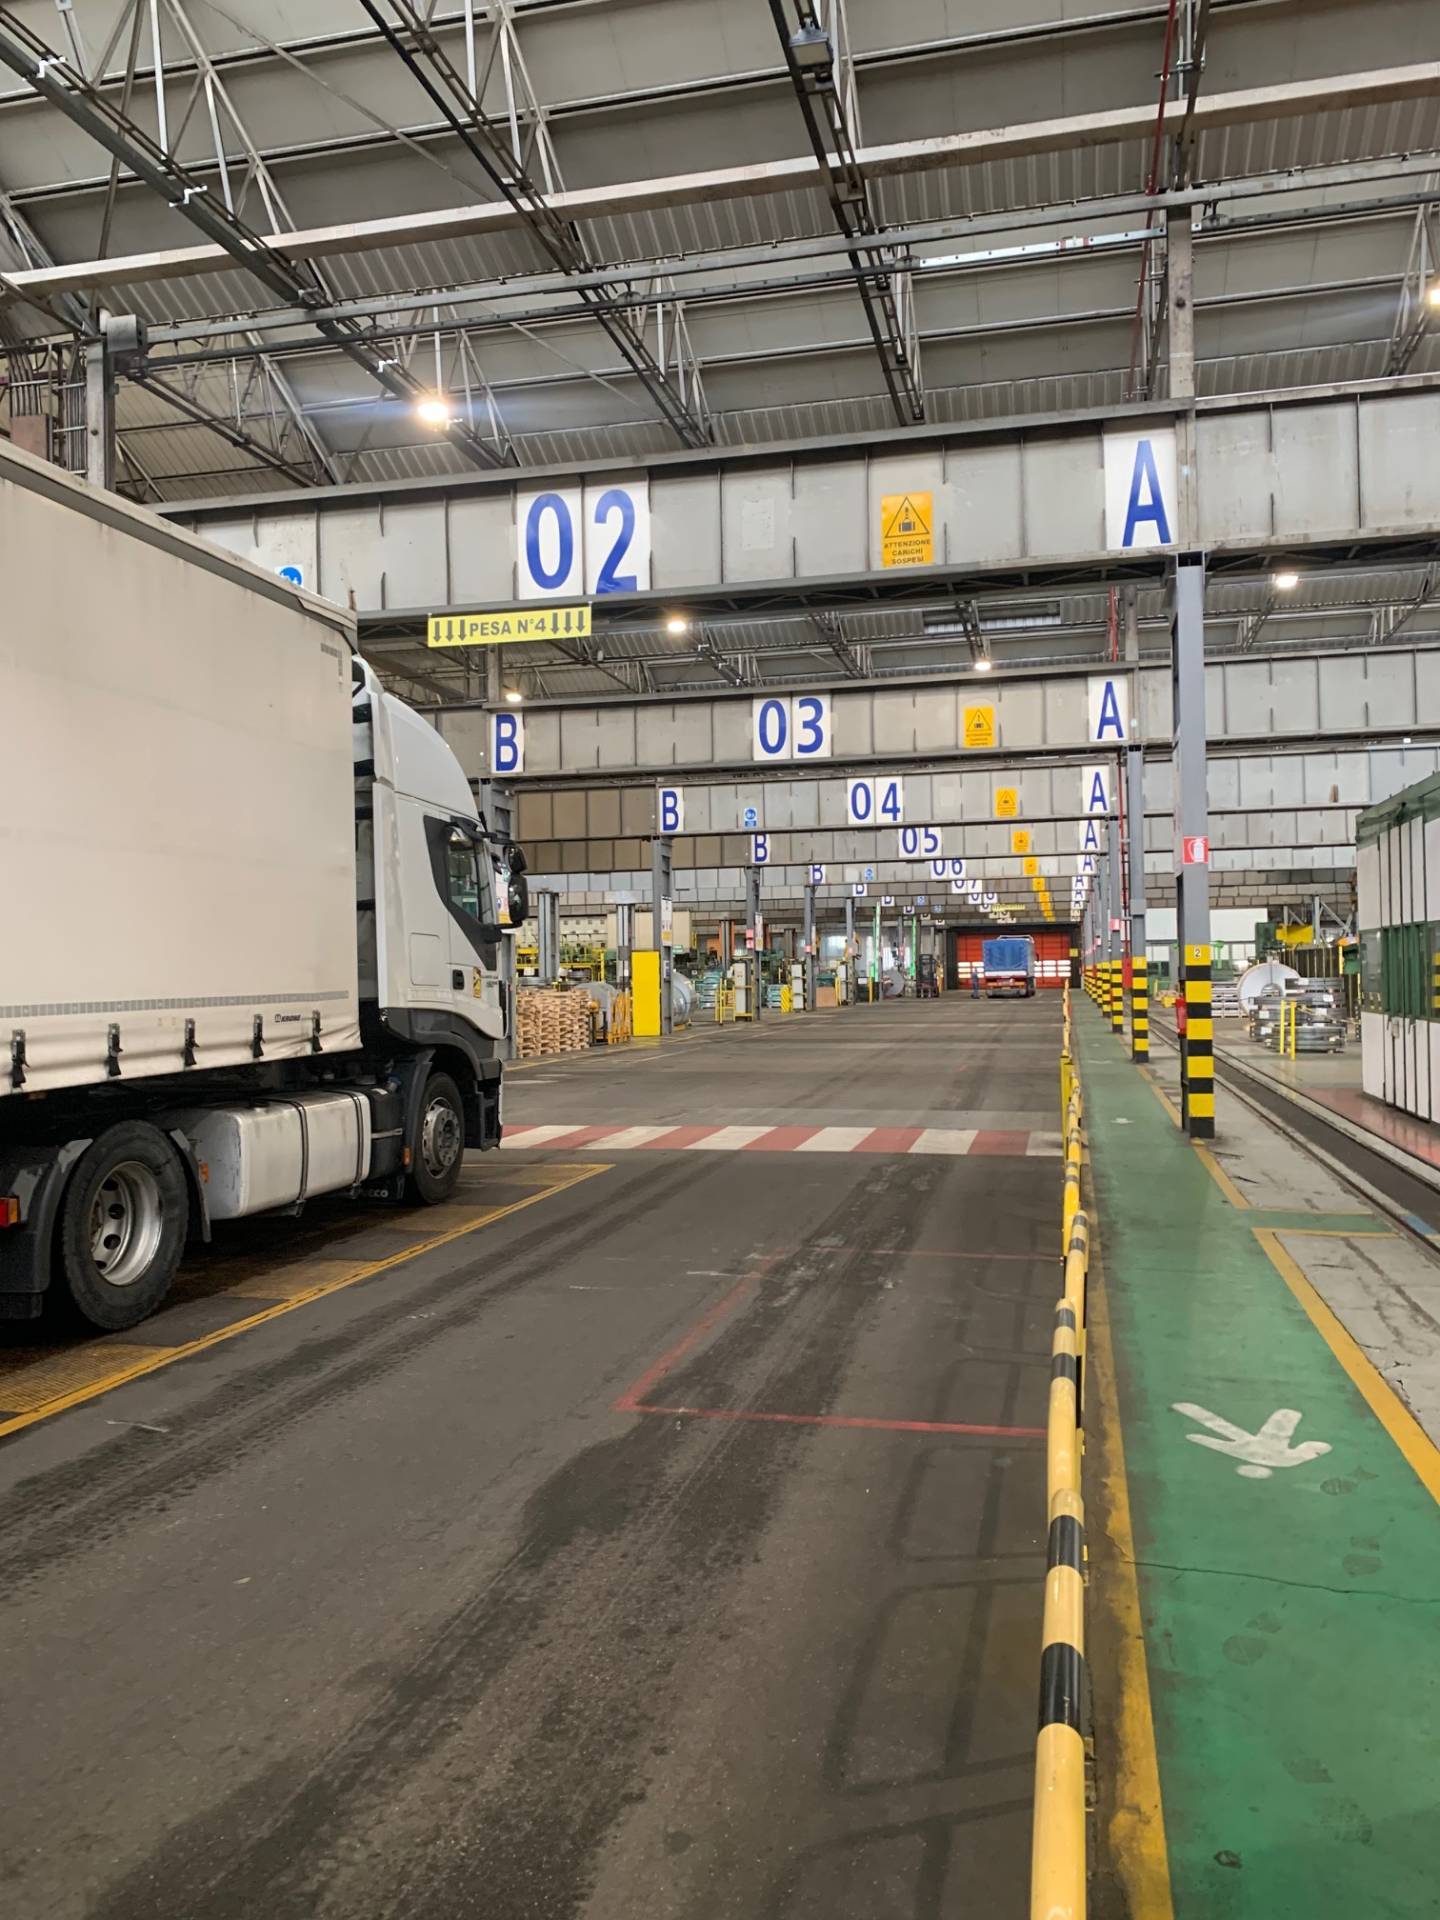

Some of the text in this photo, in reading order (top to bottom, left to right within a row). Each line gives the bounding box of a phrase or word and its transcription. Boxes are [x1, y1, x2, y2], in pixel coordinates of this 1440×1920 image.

[1121, 439, 1172, 549] A
[524, 489, 638, 596] 02
[884, 539, 931, 548] ATTENZIONE
[892, 548, 923, 556] CARICHI
[892, 556, 924, 564] SOSPESI
[469, 620, 512, 637] PESA
[758, 697, 824, 756] 03
[1097, 680, 1124, 739] A
[494, 714, 519, 773] B
[850, 781, 901, 822] 04
[1089, 772, 1107, 812] A
[661, 790, 679, 833] B
[754, 831, 768, 863] B
[901, 826, 940, 853] 05
[1084, 820, 1098, 849] A
[1194, 948, 1201, 958] 2
